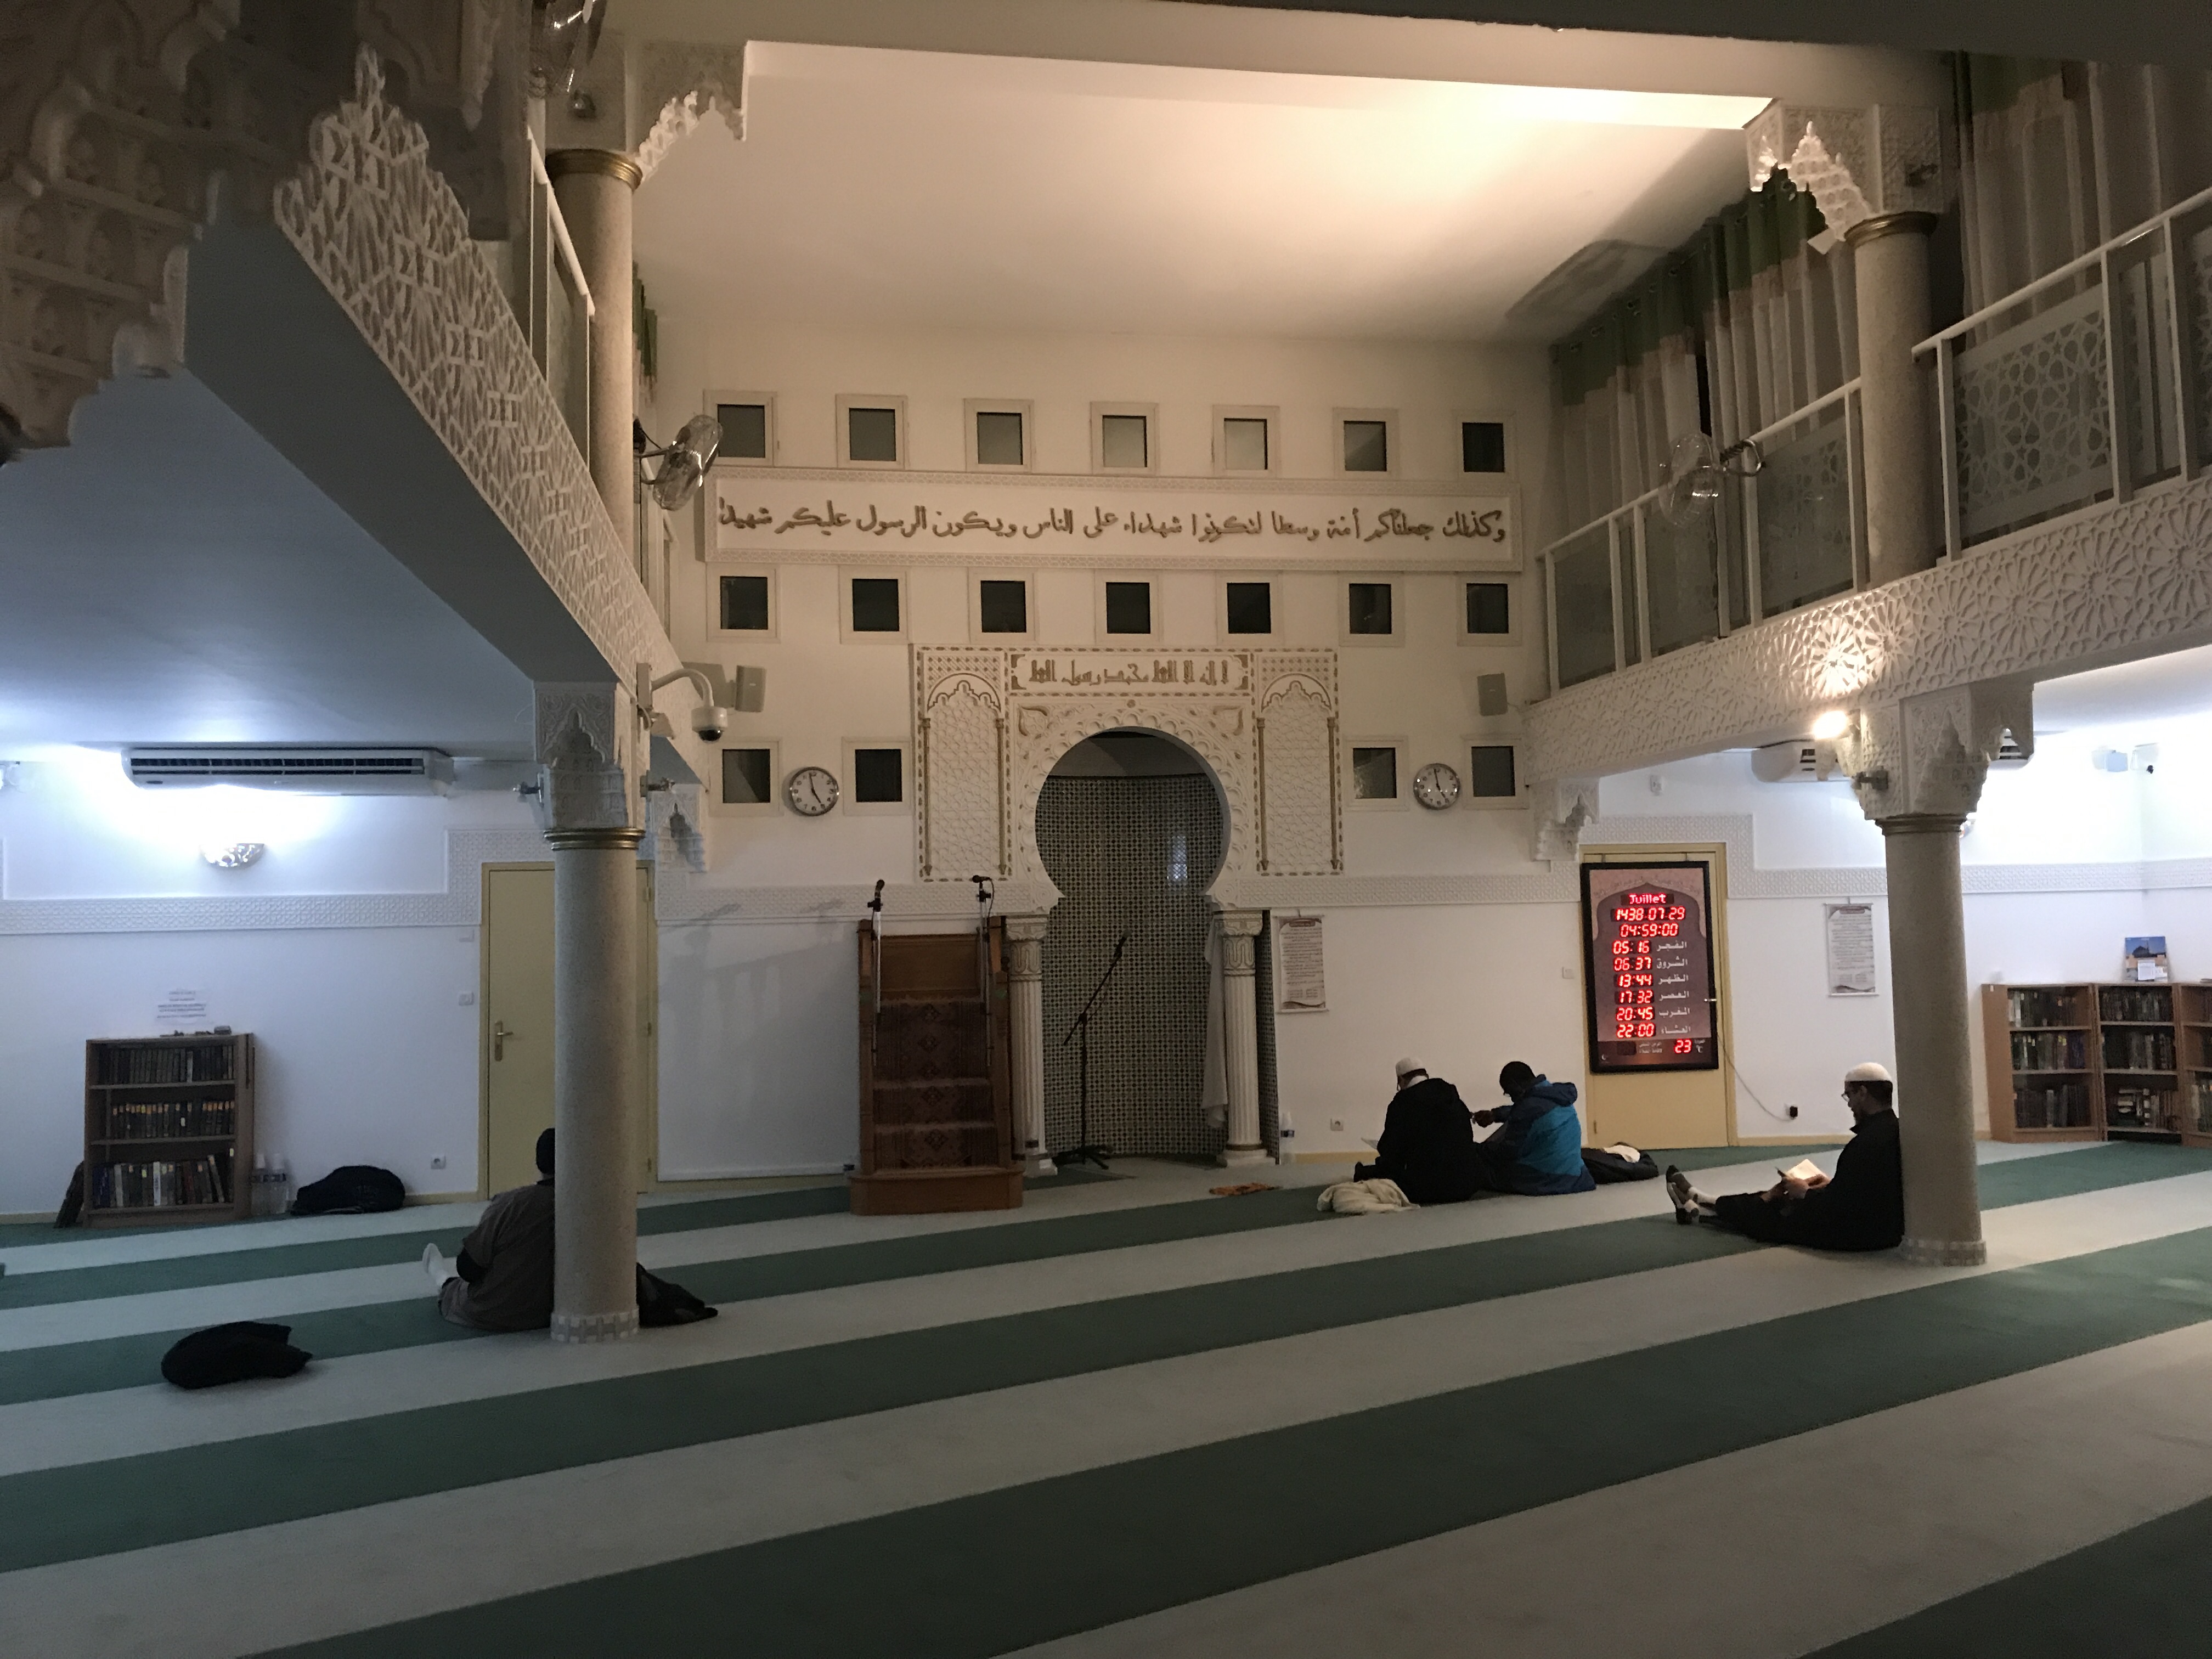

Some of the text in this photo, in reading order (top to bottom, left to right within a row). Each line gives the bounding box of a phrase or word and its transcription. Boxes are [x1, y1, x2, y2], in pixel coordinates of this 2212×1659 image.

[856, 504, 927, 538] الرسول
[1022, 507, 1073, 539] الناس
[1629, 894, 1666, 905] Juillet
[1621, 923, 1679, 938] 04:59:00
[1657, 940, 1687, 951] الفجر
[1656, 956, 1688, 969] الشروق
[1618, 974, 1653, 988] 13:44
[1658, 974, 1689, 985] الظهر
[1659, 990, 1689, 1001] العصر
[1616, 1006, 1654, 1021] 20:45
[1661, 1024, 1691, 1035] العشاء
[1674, 1039, 1692, 1054] 23
